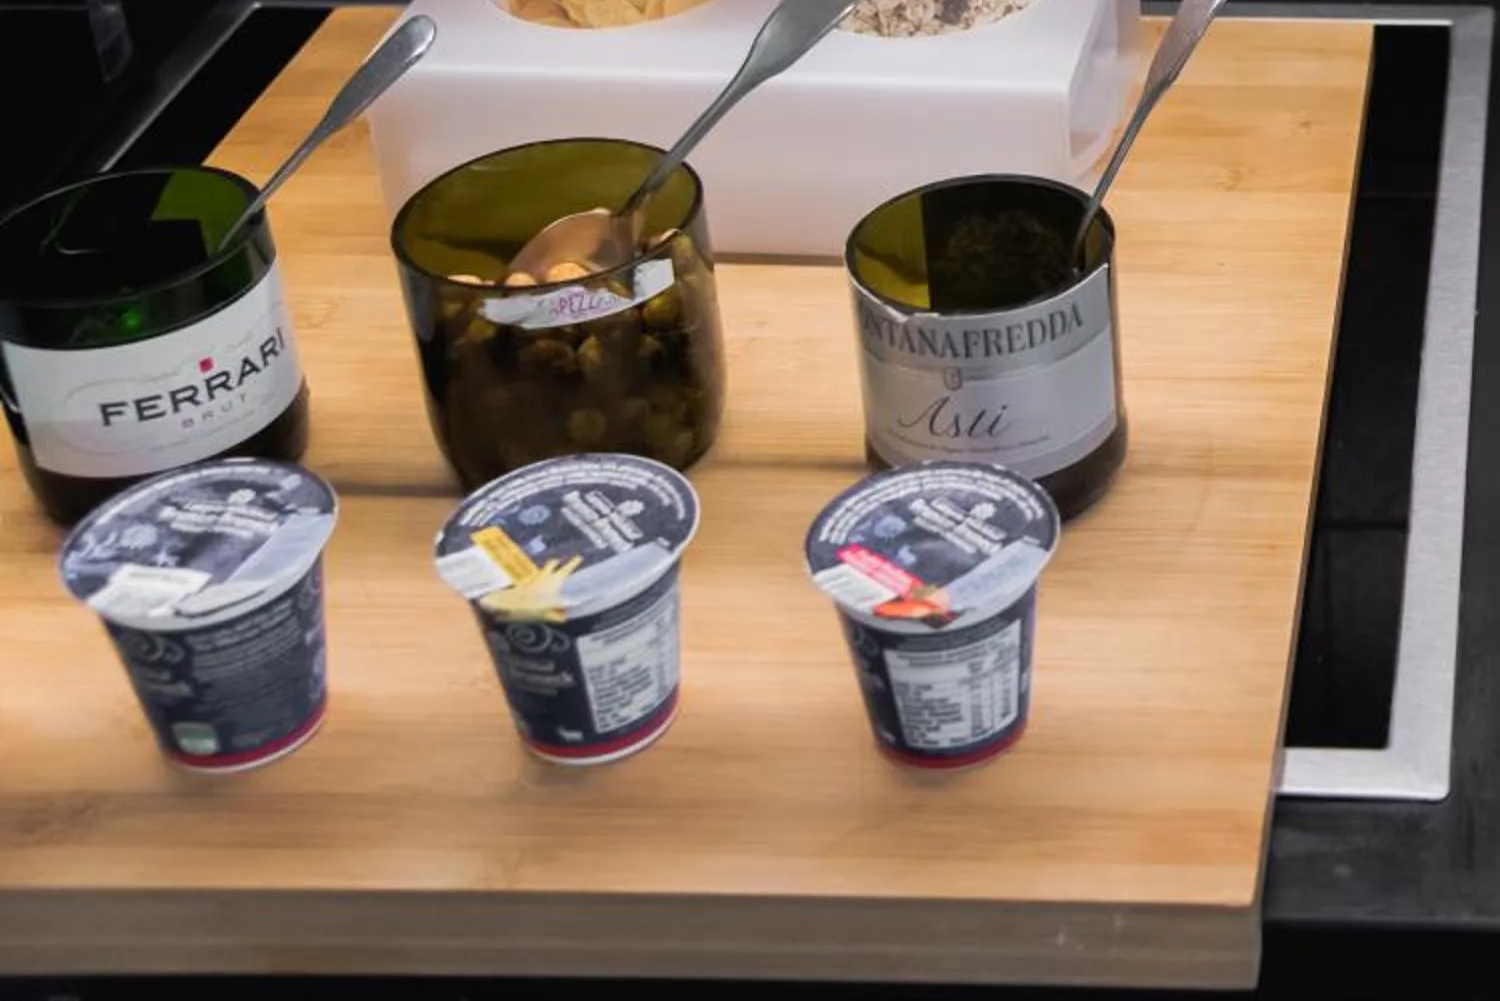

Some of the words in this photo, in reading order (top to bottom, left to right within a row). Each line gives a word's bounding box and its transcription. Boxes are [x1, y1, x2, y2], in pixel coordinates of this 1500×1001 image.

[98, 326, 286, 426] FERRARI
[179, 393, 261, 429] BRUT
[897, 395, 1009, 438] Asti
